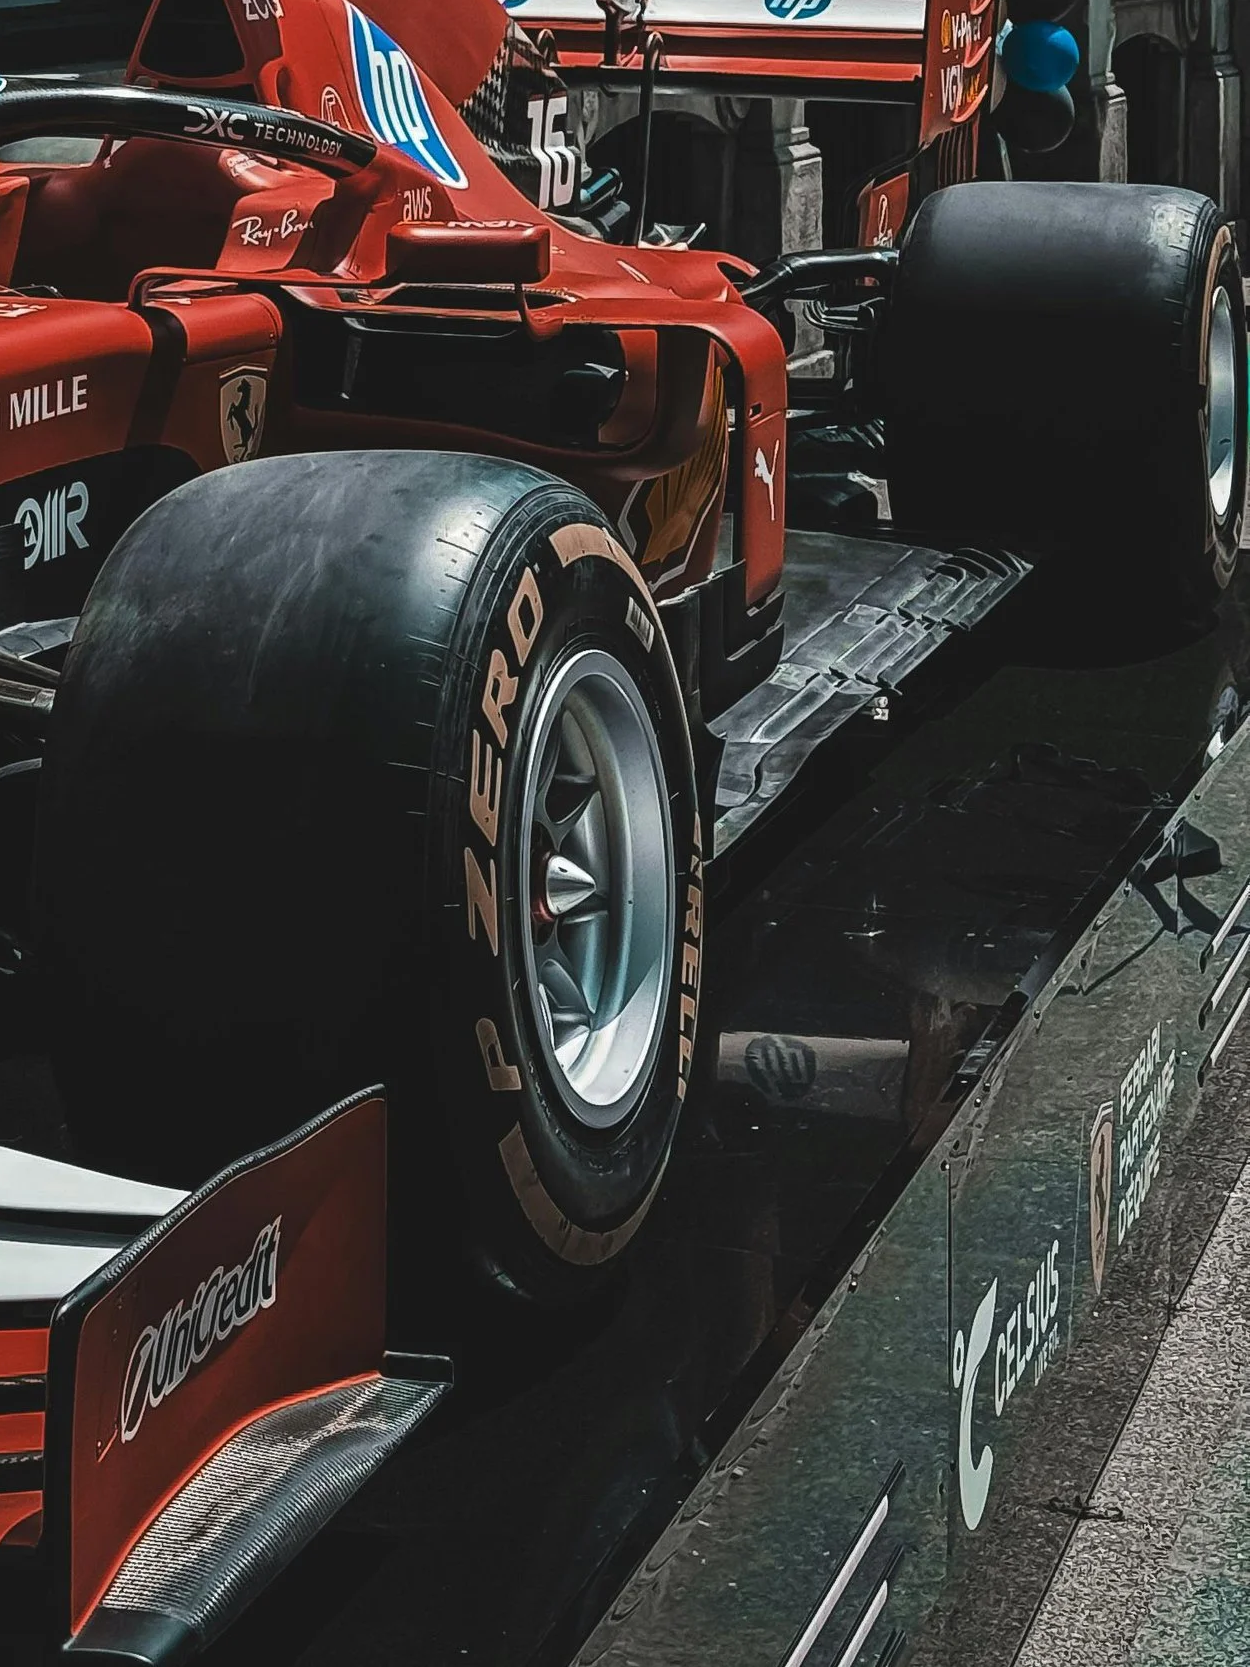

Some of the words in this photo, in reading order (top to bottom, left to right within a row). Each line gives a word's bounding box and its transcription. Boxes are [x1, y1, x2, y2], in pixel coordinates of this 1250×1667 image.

[184, 104, 248, 141] DXC
[253, 121, 343, 157] TECHNOLOGY
[351, 4, 456, 186] hp
[403, 185, 432, 222] aws
[527, 92, 576, 211] 16
[231, 208, 315, 247] Ray-Ban
[9, 374, 88, 430] MILLE
[464, 566, 544, 957] ZERO
[1120, 1021, 1161, 1126] FERRARI
[150, 1215, 282, 1408] UniCredit
[994, 1239, 1059, 1417] CELSIUS
